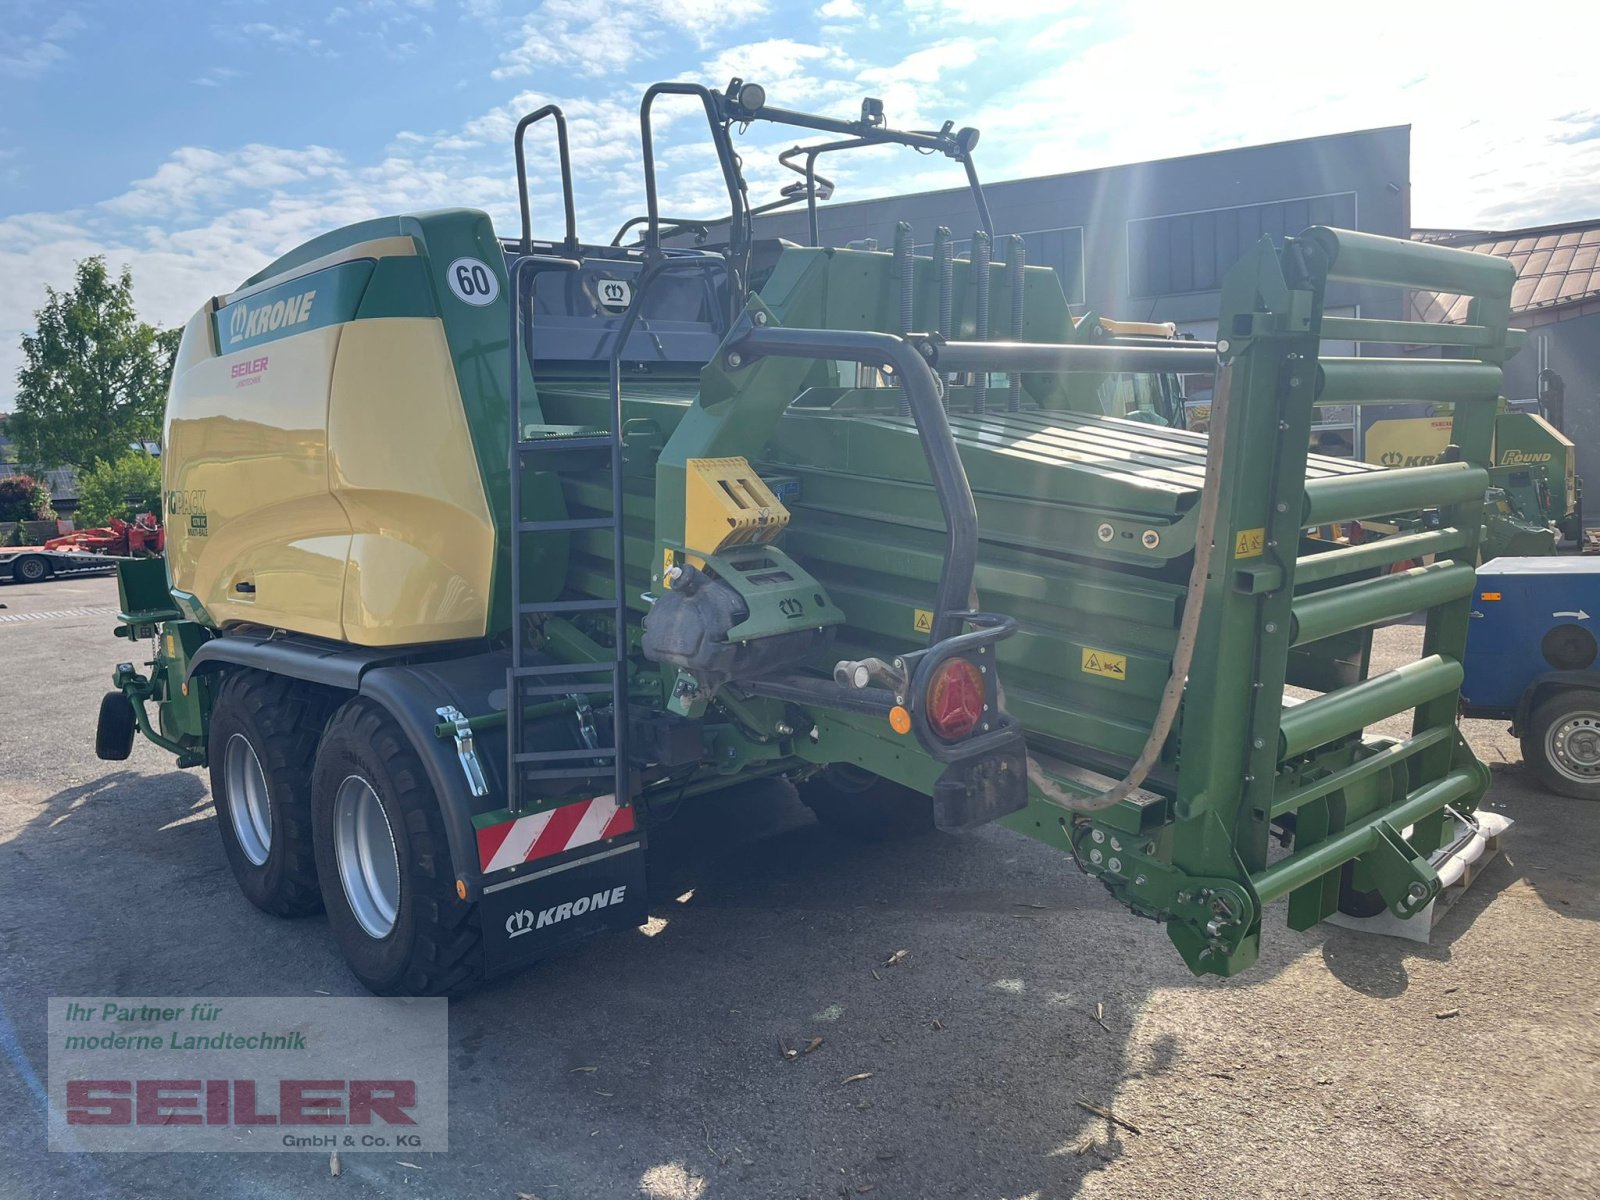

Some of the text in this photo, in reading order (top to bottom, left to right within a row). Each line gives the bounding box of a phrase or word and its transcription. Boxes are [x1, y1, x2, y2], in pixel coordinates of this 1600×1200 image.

[456, 264, 491, 296] 60
[245, 290, 316, 339] KRONE
[231, 356, 269, 379] SEILER
[535, 885, 627, 929] KRONE
